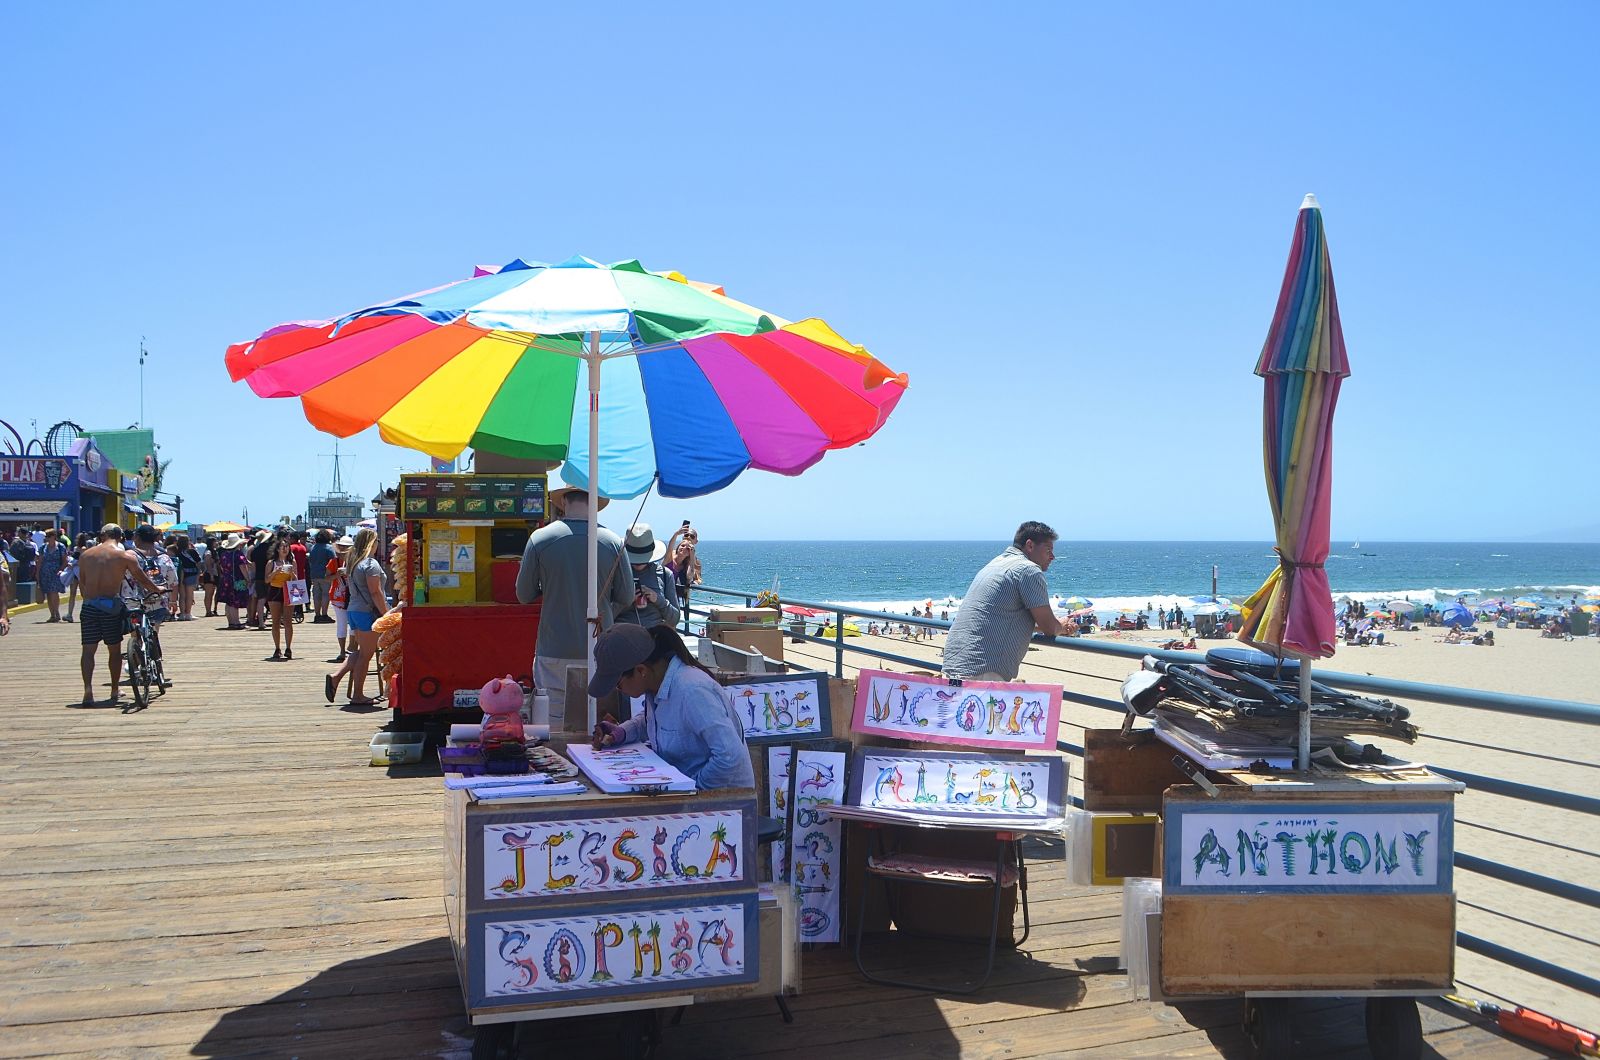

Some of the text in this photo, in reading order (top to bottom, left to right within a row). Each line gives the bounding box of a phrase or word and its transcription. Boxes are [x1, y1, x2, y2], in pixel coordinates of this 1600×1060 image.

[0, 460, 38, 482] PLAY
[457, 546, 469, 559] A
[867, 680, 1045, 736] VICTORIA
[1275, 819, 1319, 827] ANTHONY
[490, 820, 738, 892] JESSICA
[1193, 828, 1431, 880] ANTHONY
[498, 917, 738, 988] SOPHIA
